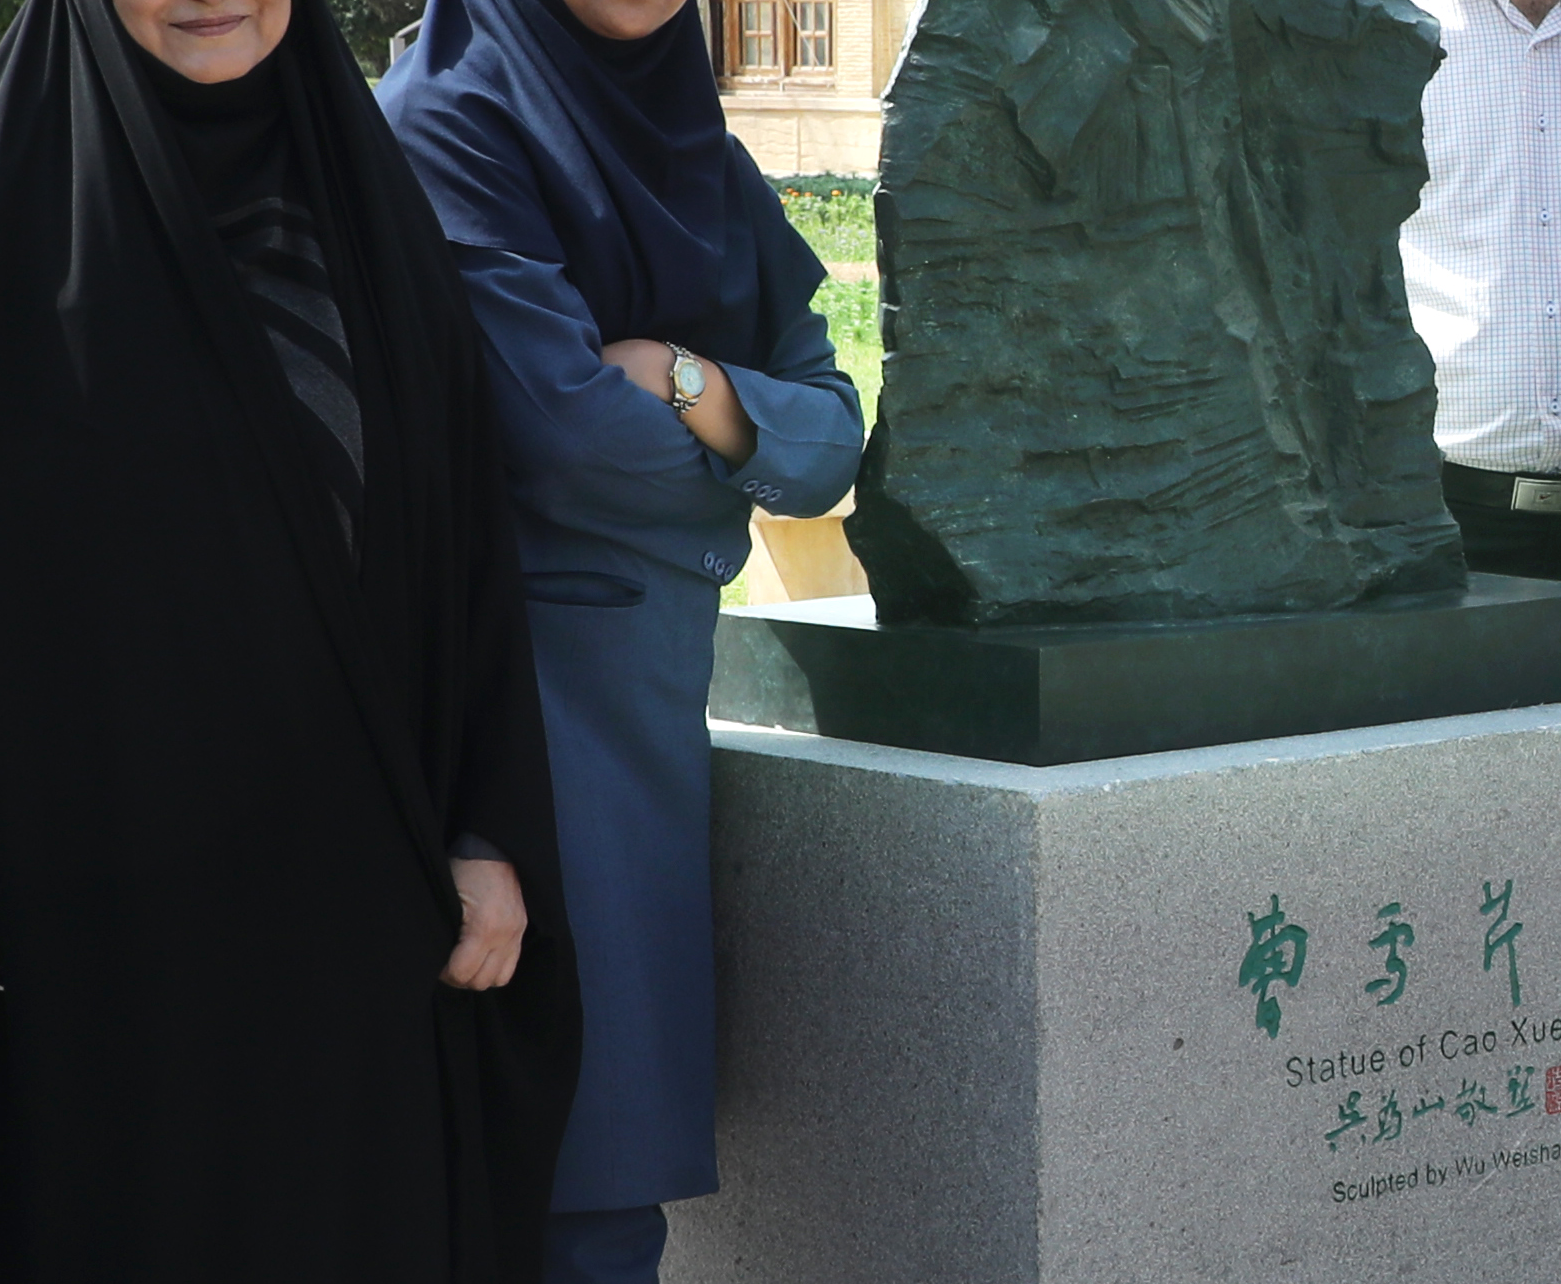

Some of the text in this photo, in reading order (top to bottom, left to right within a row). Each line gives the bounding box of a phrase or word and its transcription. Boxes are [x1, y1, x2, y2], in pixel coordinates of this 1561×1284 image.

[1285, 1049, 1386, 1087] Statue
[1399, 1034, 1427, 1067] of
[1439, 1029, 1497, 1060] Cao
[1333, 1167, 1418, 1204] Sculpted
[1426, 1162, 1447, 1187] by
[1455, 1155, 1485, 1178] Wu
